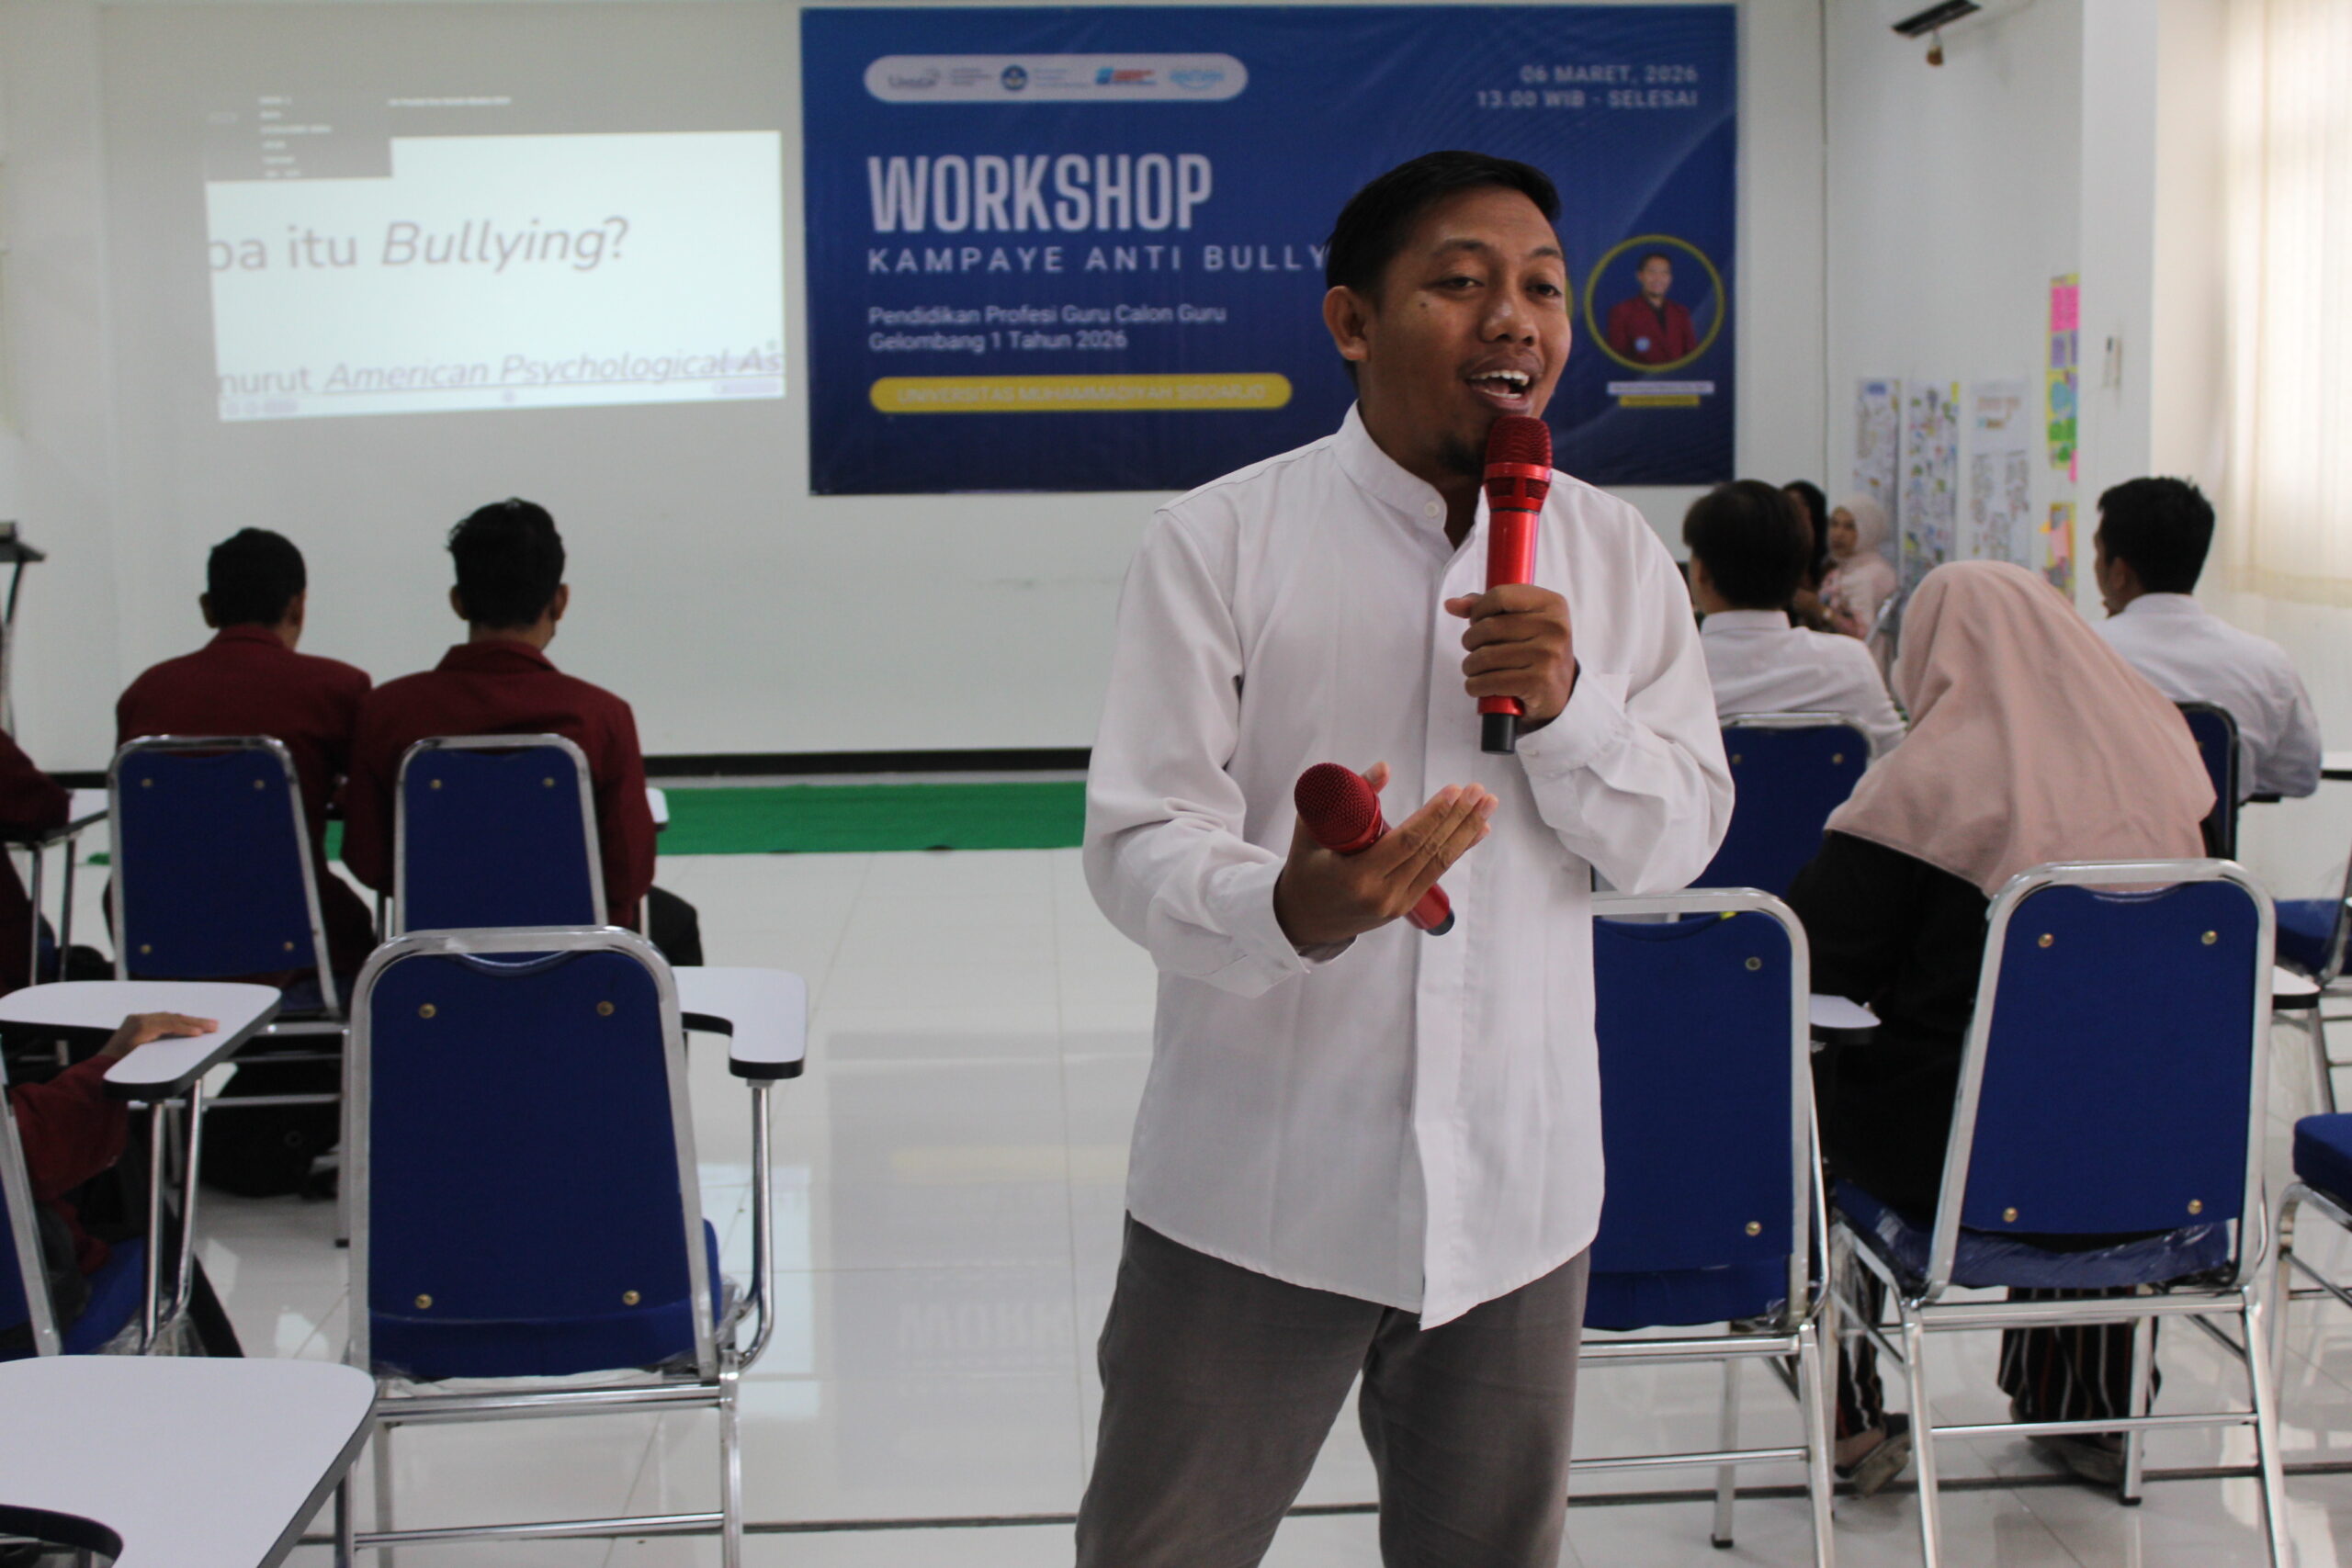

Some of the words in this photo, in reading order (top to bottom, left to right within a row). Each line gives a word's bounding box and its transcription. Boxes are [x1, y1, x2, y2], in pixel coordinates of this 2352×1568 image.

[1520, 64, 1549, 85] 06
[1644, 64, 1698, 85] 2026
[1477, 89, 1538, 109] 13.00
[1543, 89, 1585, 108] WIB
[1608, 89, 1698, 108] SELESAI
[867, 153, 1213, 233] WORKSHOP
[287, 223, 357, 269] itu
[379, 215, 630, 273] Bullying?
[867, 245, 1063, 274] KAMPAYE
[1084, 245, 1181, 272] ANTI
[868, 305, 981, 326] Pendidikan
[984, 304, 1057, 325] Profesi
[1060, 304, 1112, 325] Guru
[1114, 303, 1174, 324] Calon
[1177, 303, 1227, 324] Guru
[868, 332, 986, 355] Gelombang
[990, 331, 1001, 349] 1
[1008, 330, 1072, 351] Tahun
[1076, 329, 1128, 350] 2026
[323, 360, 490, 389] American
[499, 348, 729, 387] Psychological
